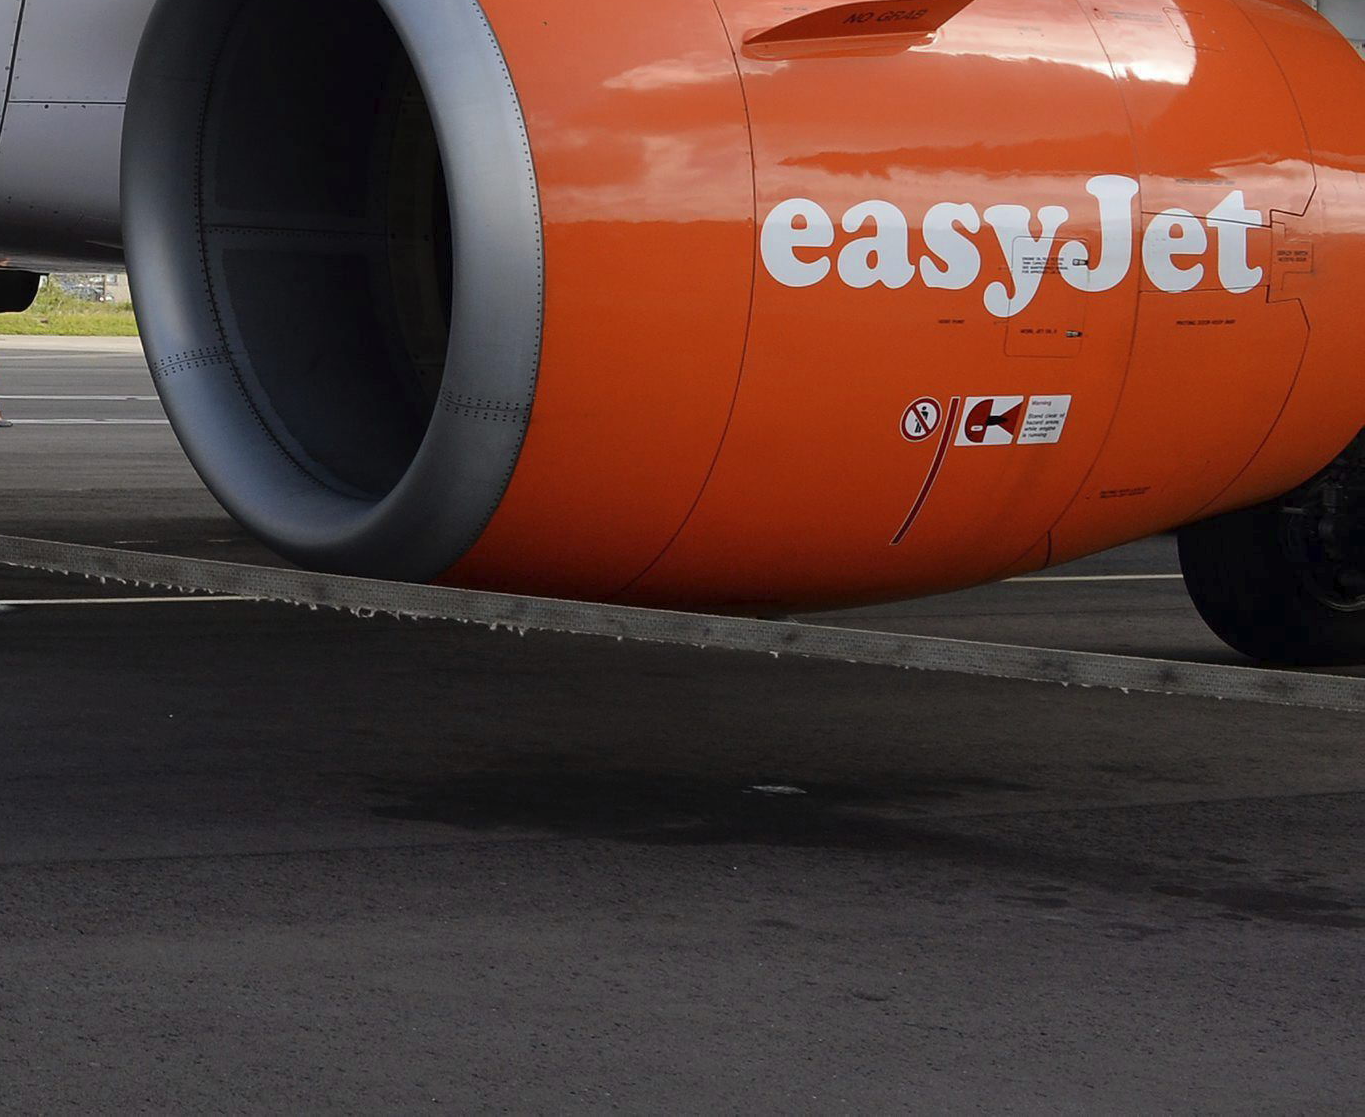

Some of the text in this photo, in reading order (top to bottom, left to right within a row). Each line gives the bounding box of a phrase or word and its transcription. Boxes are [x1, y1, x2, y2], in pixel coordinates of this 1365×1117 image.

[843, 8, 928, 25] NO GRAB
[759, 174, 1264, 319] easyJet
